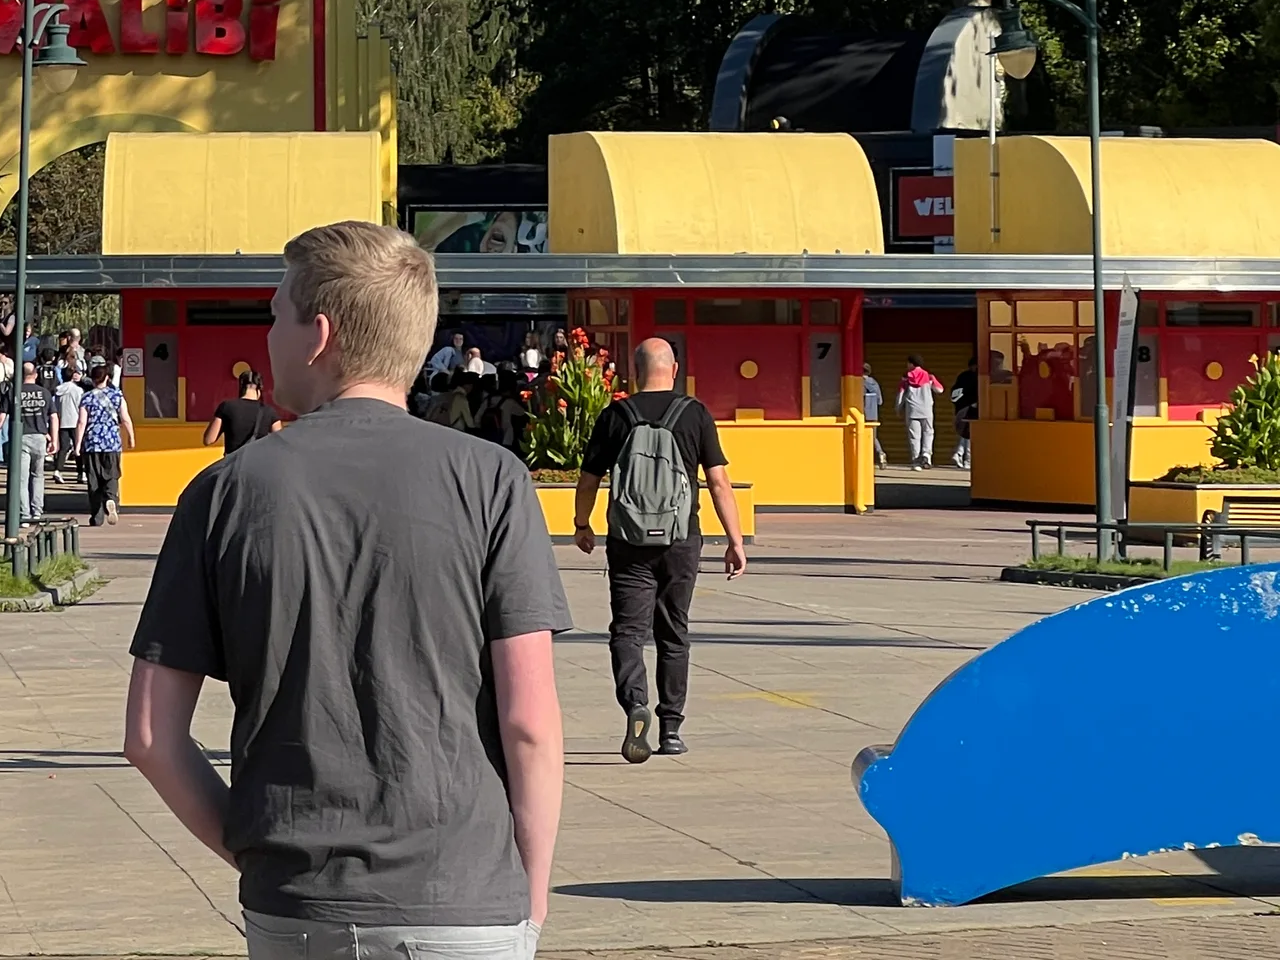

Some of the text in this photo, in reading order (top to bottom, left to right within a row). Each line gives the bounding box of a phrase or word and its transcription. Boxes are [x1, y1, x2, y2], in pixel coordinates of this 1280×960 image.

[152, 343, 170, 361] 4
[816, 342, 832, 360] 7
[1138, 345, 1151, 363] 8
